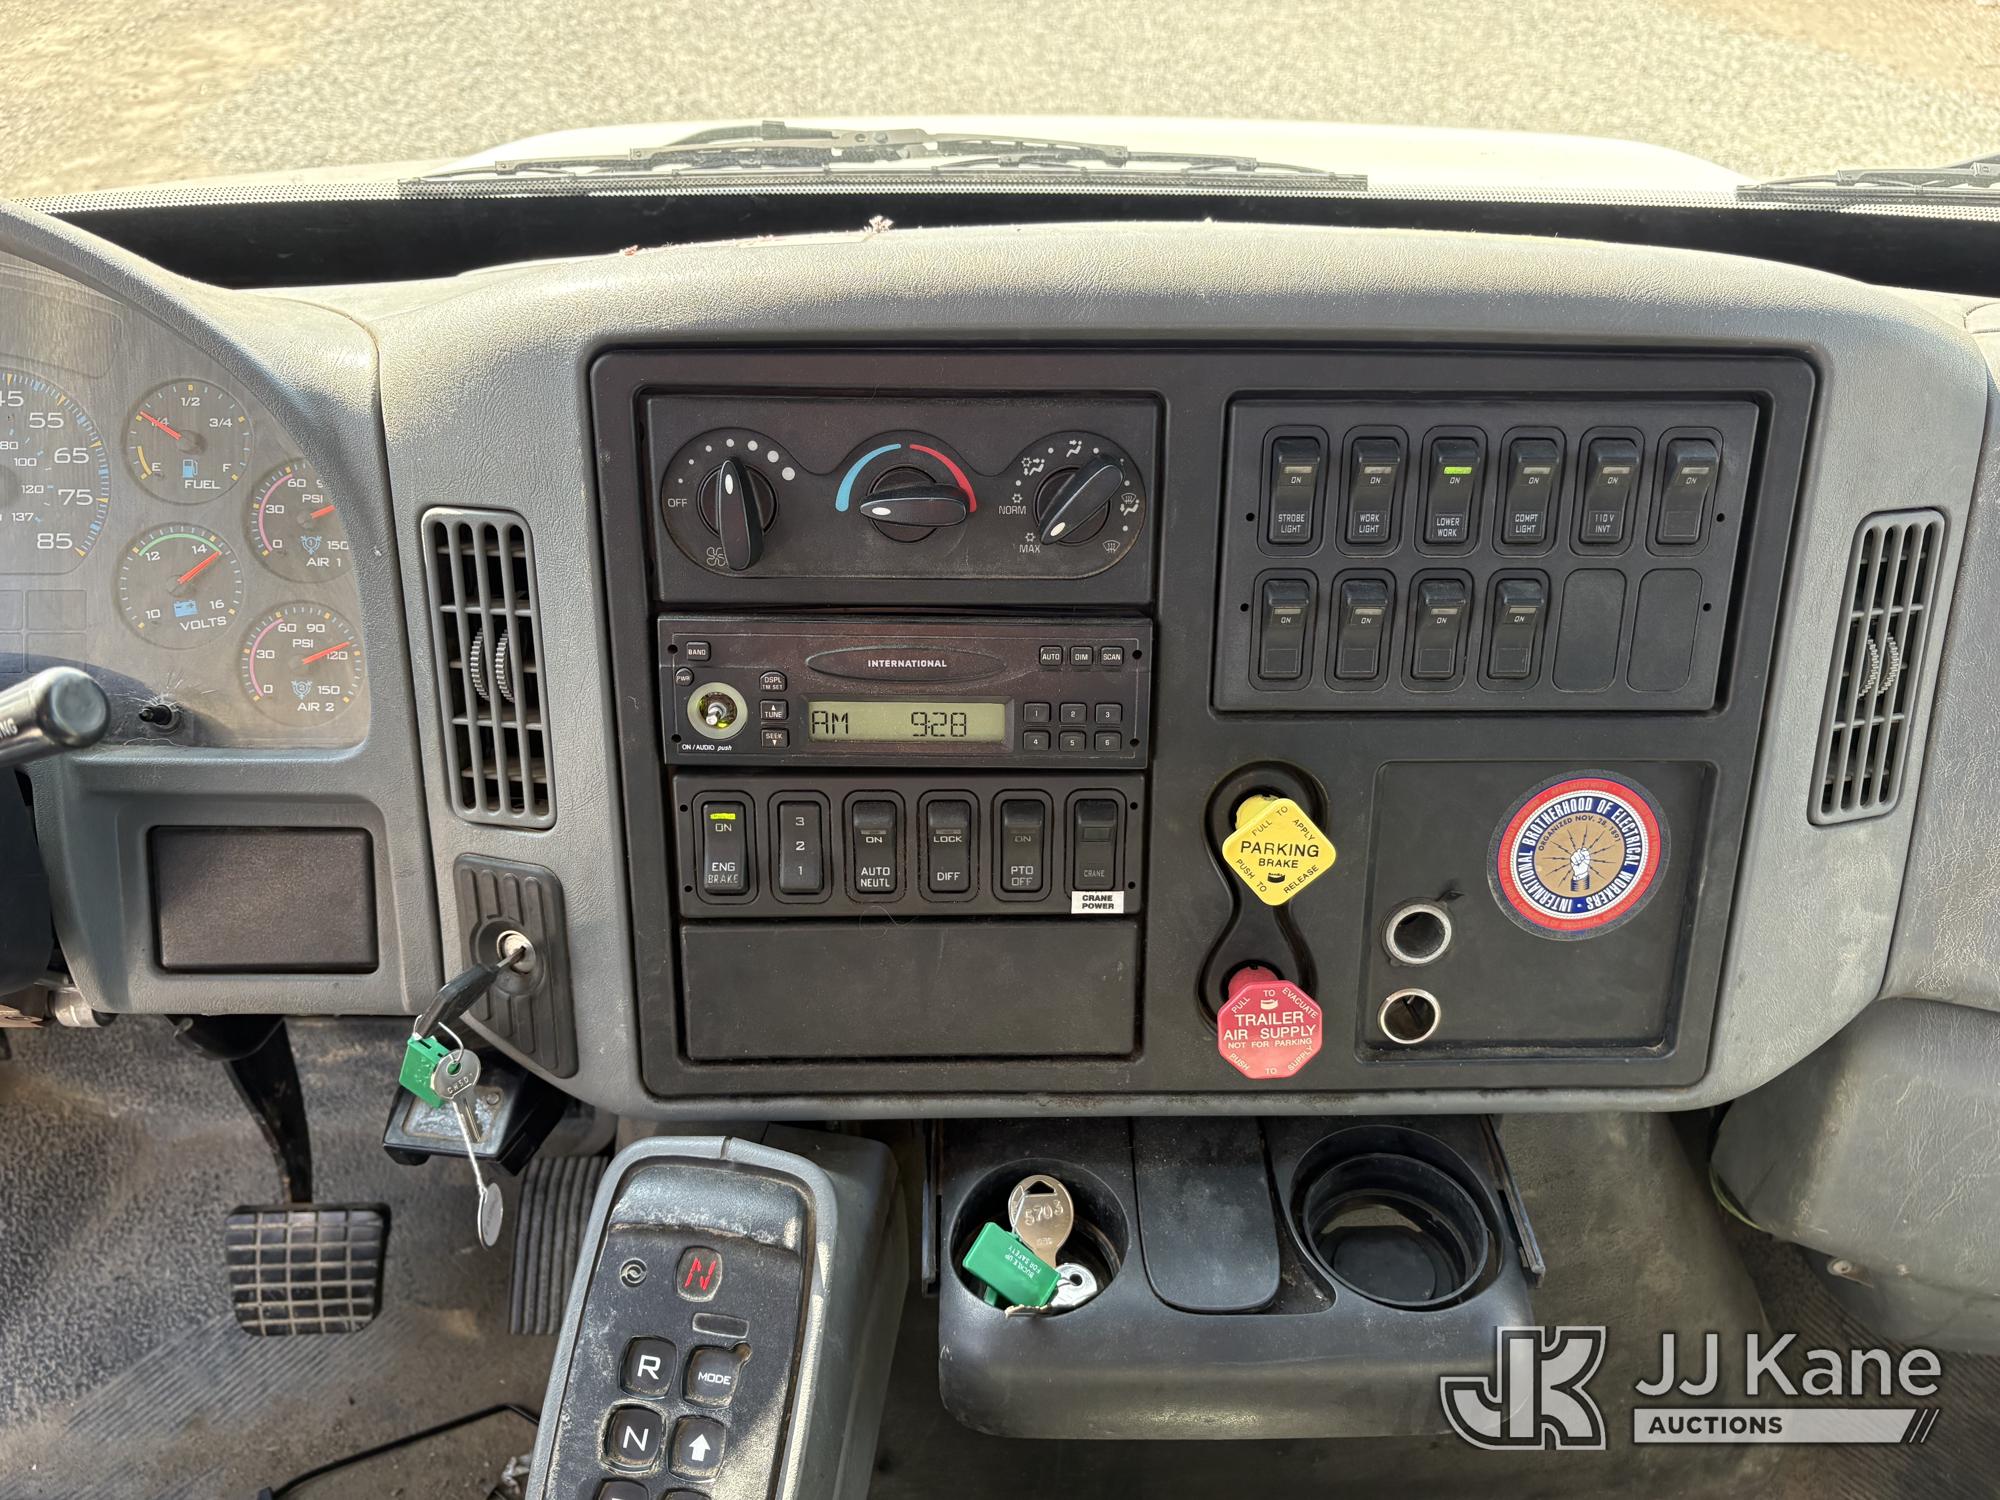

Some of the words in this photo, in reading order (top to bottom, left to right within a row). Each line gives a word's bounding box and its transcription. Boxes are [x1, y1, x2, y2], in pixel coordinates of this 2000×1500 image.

[180, 397, 200, 407] 1/2
[29, 412, 64, 428] 55
[209, 418, 233, 428] 3/4
[54, 447, 90, 464] 65
[14, 458, 37, 467] 100
[152, 462, 161, 472] E
[223, 463, 232, 473] F
[184, 480, 221, 489] FUEL
[288, 479, 306, 488] 60
[22, 485, 44, 494] 120
[58, 489, 93, 505] 75
[302, 494, 323, 504] PSI
[667, 498, 688, 508] OFF
[266, 505, 284, 514] 30
[998, 505, 1027, 515] NORM
[11, 512, 34, 522] 137
[1278, 514, 1305, 522] STROBE
[1360, 514, 1380, 522] WORK
[1436, 517, 1460, 526] LOWER
[1515, 514, 1539, 522] COMPT
[1281, 525, 1301, 533] LIGHT
[1359, 525, 1380, 533] LIGHT
[1437, 528, 1457, 537] WORK
[1515, 525, 1536, 533] LIGHT
[1595, 525, 1611, 533] INVT
[37, 533, 73, 549] 85
[272, 540, 283, 549] 0
[327, 541, 349, 550] 150
[192, 544, 207, 555] 14
[1019, 544, 1041, 554] MAX
[146, 551, 160, 561] 12
[306, 557, 330, 567] AIR
[335, 558, 341, 567] 1
[210, 599, 225, 610] 16
[145, 609, 161, 620] 10
[1514, 615, 1525, 623] ON
[180, 616, 227, 632] VOLTS
[1281, 616, 1291, 624] ON
[1436, 616, 1447, 624] ON
[278, 623, 297, 633] 60
[306, 624, 326, 633] 90
[292, 639, 314, 648] PSI
[256, 650, 275, 659] 30
[1042, 653, 1060, 661] AUTO
[1074, 653, 1088, 661] DIM
[1103, 653, 1121, 661] SCAN
[868, 659, 948, 667] INTERNATIONAL
[676, 675, 691, 683] PWR
[764, 676, 782, 684] DSPL
[263, 684, 273, 694] 0
[317, 685, 340, 695] 150
[297, 702, 320, 711] AIR
[325, 703, 335, 712] 2
[811, 710, 849, 735] AM
[911, 711, 968, 737] 9:28
[717, 744, 733, 752] push
[1597, 798, 1612, 814] OF
[795, 817, 805, 826] 3
[1251, 820, 1272, 837] PULL
[1276, 805, 1288, 816] TO
[1293, 819, 1316, 841] APPLY
[1522, 797, 1593, 847] BROTHERHOOD
[715, 823, 732, 832] ON
[1538, 817, 1573, 852] ORGANIZED
[1575, 814, 1595, 822] NOV.
[1609, 826, 1621, 843] 1891
[1611, 807, 1643, 867] ELECTRICAL
[795, 841, 805, 851] 2
[1240, 840, 1320, 858] PARKING
[712, 862, 736, 872] ENG
[1258, 857, 1299, 869] BRAKE
[861, 867, 891, 876] AUTO
[1011, 866, 1034, 875] PTO
[1083, 870, 1105, 878] CRANE
[708, 874, 738, 884] BRAKE
[937, 872, 961, 881] DIFF
[1235, 858, 1255, 879] PUSH
[1256, 881, 1267, 893] TO
[1283, 865, 1319, 894] RELEASE
[860, 878, 890, 887] NEUTL
[1012, 877, 1033, 886] OFF
[1517, 850, 1573, 913] INTERNATIONAL
[1587, 872, 1635, 910] WORKERS
[1231, 996, 1251, 1014] PULL
[1263, 989, 1276, 997] TO
[1282, 987, 1318, 1019] EVACUATE
[1234, 1010, 1304, 1027] TRAILER
[1223, 1029, 1249, 1041] AIR
[1260, 1024, 1317, 1039] SUPPLY
[1228, 1041, 1247, 1049] NOT
[1251, 1040, 1270, 1048] FOR
[1274, 1037, 1312, 1047] PARKING
[1229, 1052, 1250, 1071] PUSH
[1264, 1067, 1278, 1075] TO
[1287, 1045, 1314, 1071] SUPPLY
[1008, 1245, 1030, 1265] SAFETY
[1013, 1258, 1035, 1279] BUCKLE
[1029, 1262, 1042, 1275] FOR
[685, 1257, 717, 1291] N
[637, 1354, 662, 1380] R
[698, 1371, 731, 1386] MODE
[623, 1425, 649, 1452] N
